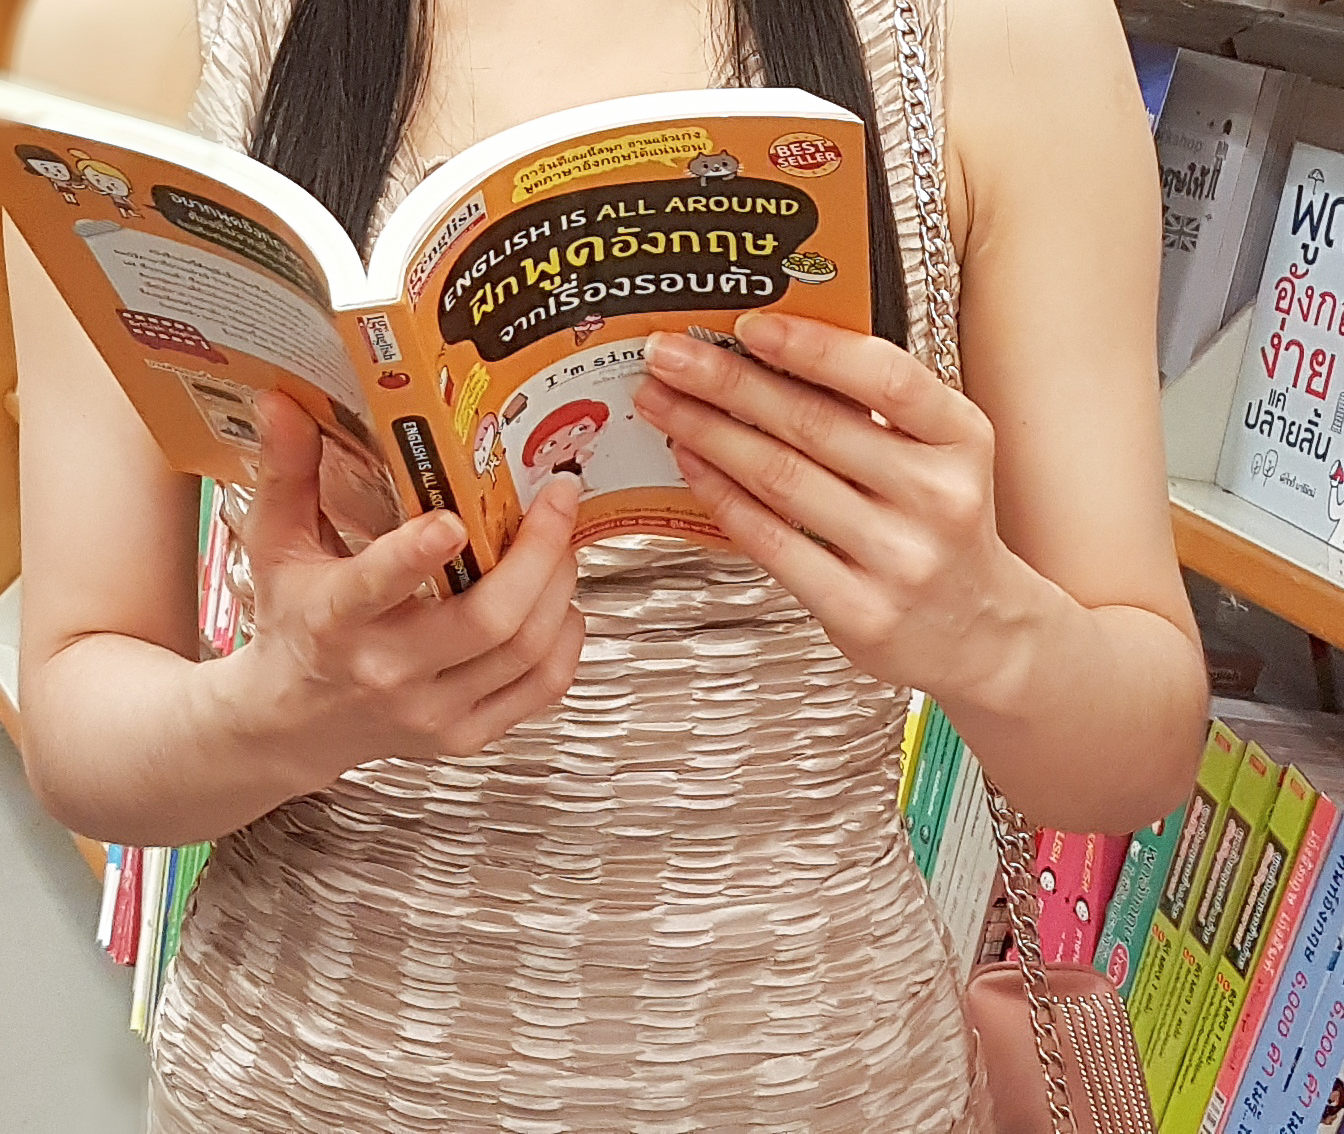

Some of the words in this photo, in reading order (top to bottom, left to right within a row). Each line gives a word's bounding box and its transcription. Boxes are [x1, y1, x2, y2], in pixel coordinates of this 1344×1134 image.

[774, 138, 827, 159] BEST
[775, 149, 839, 170] SELLER
[442, 224, 552, 312] ENGLISH
[560, 208, 588, 230] IS
[596, 197, 657, 222] ALL
[663, 195, 800, 218] AROUND
[469, 226, 779, 327] ฝึกพูดอังกฤษ
[497, 266, 775, 344] จากเรื่องรอบตัว
[1260, 316, 1336, 402] ง่าย
[545, 364, 585, 389] I'm
[1267, 387, 1288, 411] แค่
[402, 421, 427, 461] ENGLISH
[1243, 400, 1333, 463] ปลายลิ้น
[418, 460, 433, 472] IS
[421, 471, 436, 490] ALL
[1277, 970, 1308, 1039] 6,000
[1264, 1047, 1284, 1079] คำ
[1301, 1077, 1322, 1109] คำ
